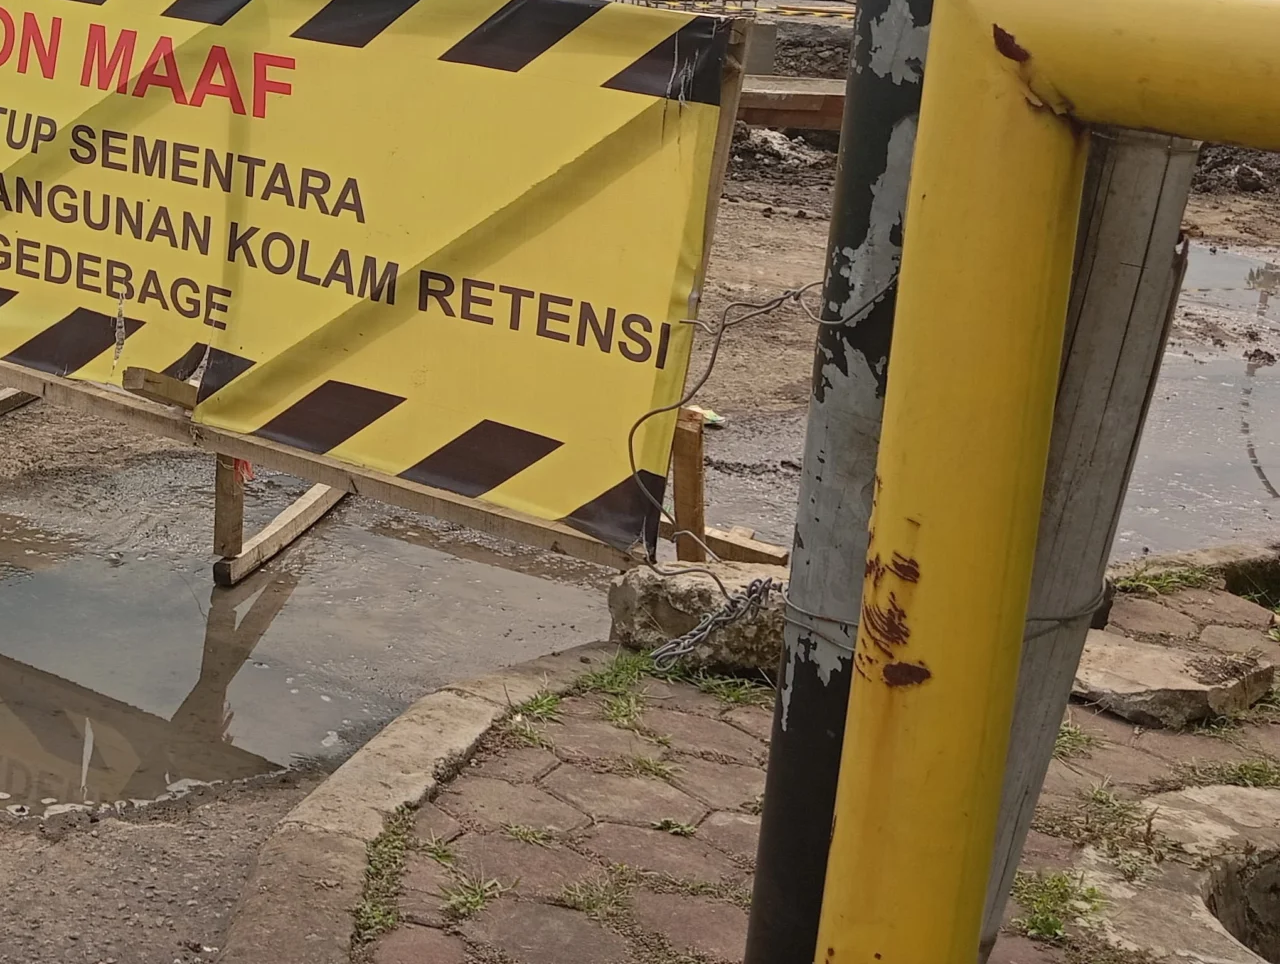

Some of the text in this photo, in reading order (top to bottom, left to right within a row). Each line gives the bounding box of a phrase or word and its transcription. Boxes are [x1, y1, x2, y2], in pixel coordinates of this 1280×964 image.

[79, 22, 296, 119] MAAF
[68, 123, 367, 224] SEMENTARA
[226, 221, 400, 306] KOLAM
[417, 268, 672, 371] RETENSI
